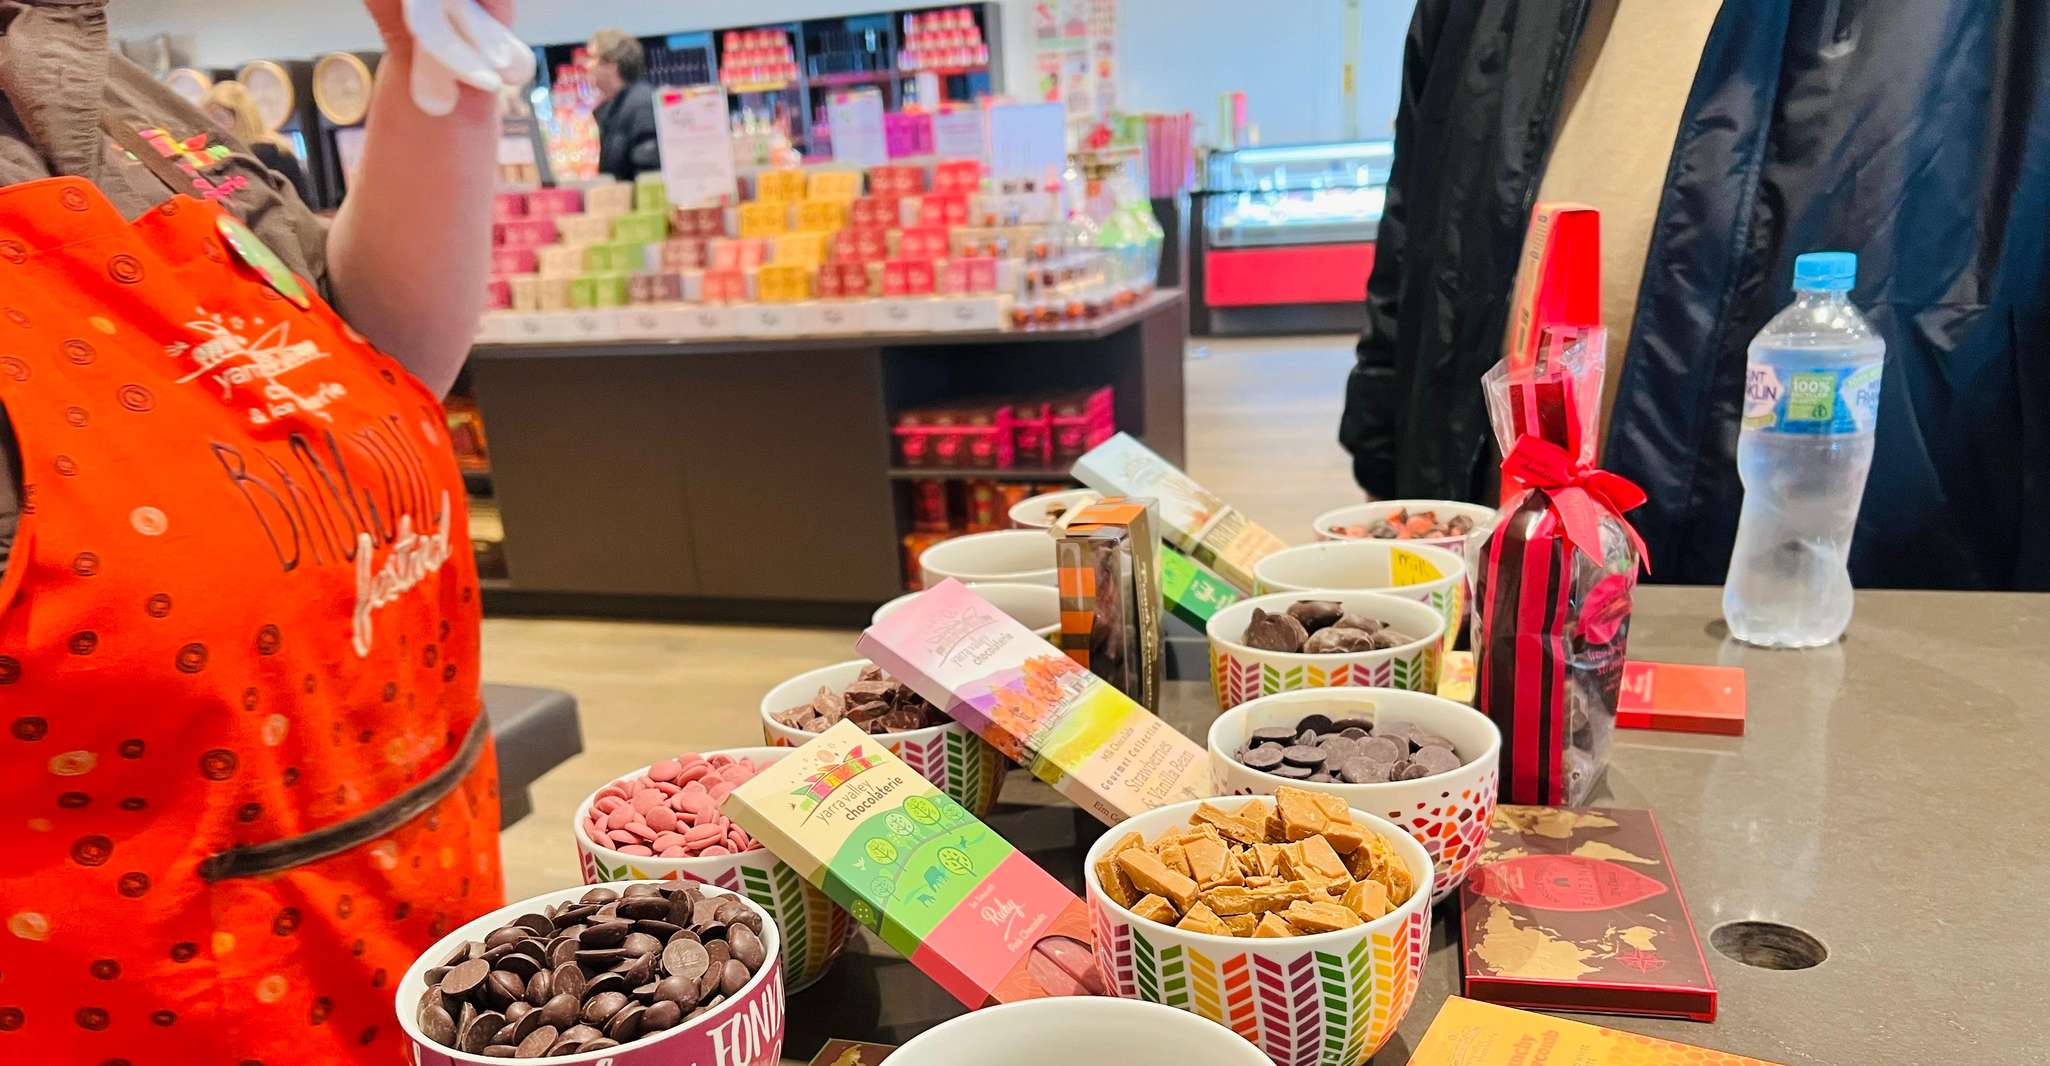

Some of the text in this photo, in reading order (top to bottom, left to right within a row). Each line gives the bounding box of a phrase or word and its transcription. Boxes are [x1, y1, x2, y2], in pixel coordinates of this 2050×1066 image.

[1100, 758, 1132, 791] Gourmet
[1128, 721, 1162, 757] Collection
[1124, 740, 1173, 793] Strawberries
[1146, 769, 1181, 801] Vanilla
[1169, 750, 1195, 773] Bean
[815, 779, 875, 825] yarra valley
[846, 776, 903, 821] chocolaterie
